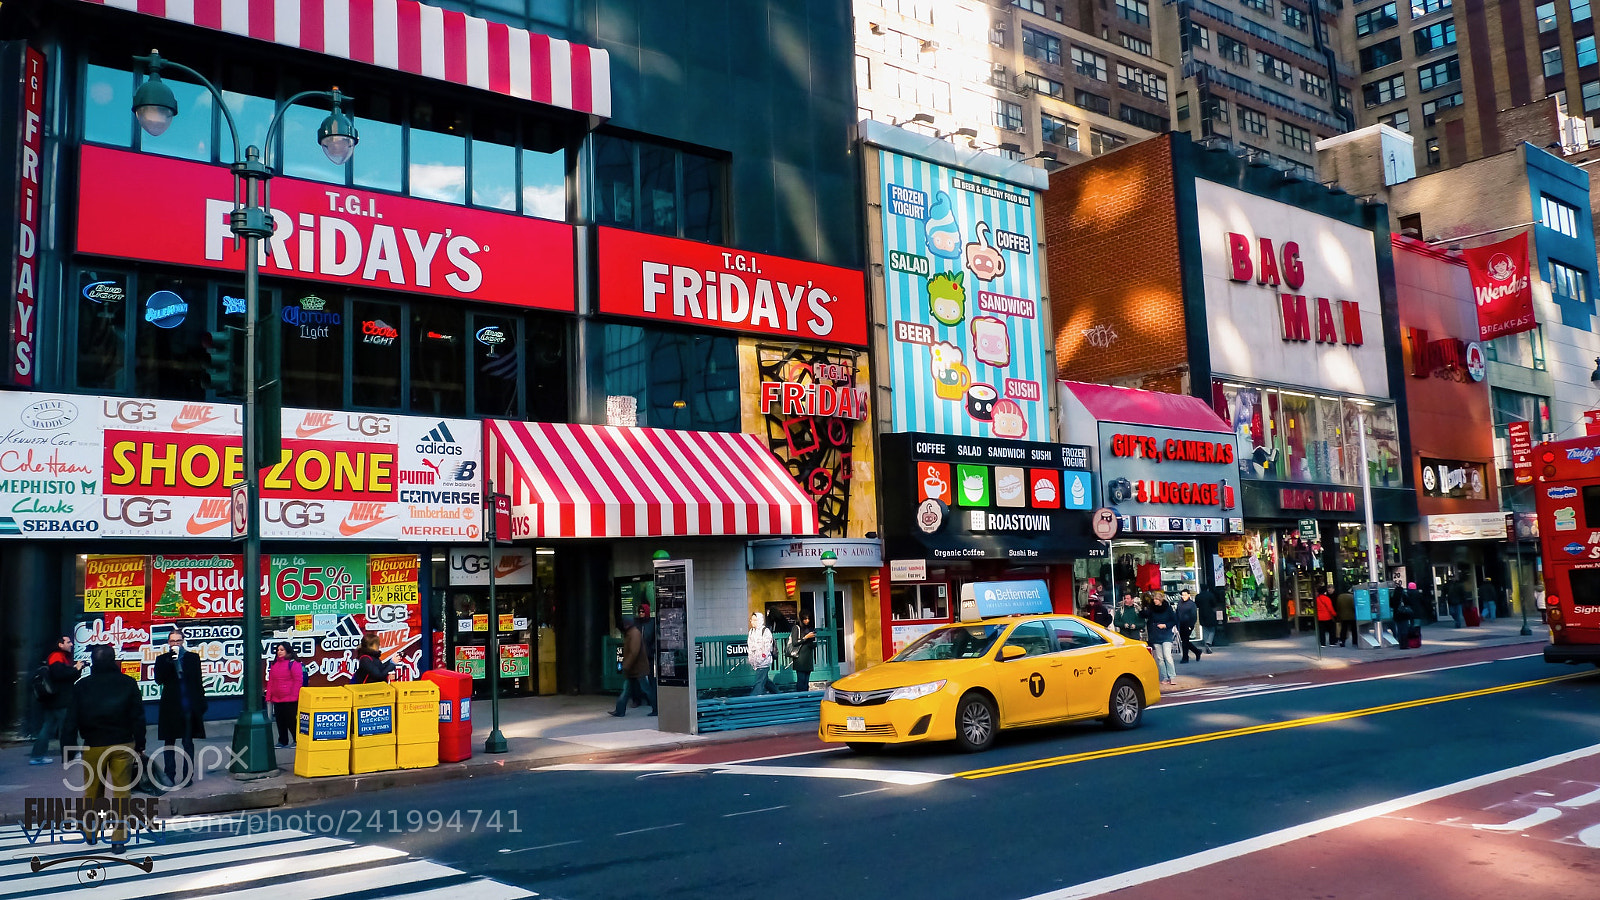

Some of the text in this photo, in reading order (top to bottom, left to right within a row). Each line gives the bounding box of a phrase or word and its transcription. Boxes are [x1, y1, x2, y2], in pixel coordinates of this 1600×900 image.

[892, 186, 924, 206] FROZEN
[976, 185, 981, 193] &
[982, 187, 1004, 199] HEALTHY
[1005, 193, 1018, 202] FOOD
[1018, 197, 1030, 206] BAR
[325, 191, 383, 218] T.G.I.
[892, 201, 925, 220] YOGURT
[997, 231, 1030, 252] COFFEE
[721, 252, 762, 274] T.G.I.
[891, 253, 929, 275] SALAD
[1224, 232, 1305, 290] BAG
[642, 260, 834, 336] FRiDAY'S
[980, 293, 1034, 317] SANDWICH
[281, 305, 341, 327] Corona
[1276, 293, 1364, 346] MAN
[300, 324, 329, 340] Light
[362, 320, 398, 338] Coors
[1480, 314, 1533, 335] BREAKFAS
[363, 334, 395, 346] LIGHT
[899, 323, 932, 344] BEER
[819, 363, 847, 381] T.G.I.
[1008, 380, 1038, 399] SUSHI
[31, 401, 64, 412] STEVE
[103, 400, 157, 424] UGG
[179, 404, 214, 421] NIKE
[31, 414, 72, 429] MADDEN
[302, 412, 335, 428] NIKE
[346, 414, 391, 437] UGG
[415, 442, 463, 457] adidas
[916, 442, 946, 455] COFFEE
[957, 445, 982, 457] SALAD
[987, 447, 1026, 460] SANDWICH
[1031, 449, 1051, 461] SUSHI
[1061, 447, 1087, 458] FROZEN
[1111, 433, 1233, 464] GIFTS, CAMERAS
[1513, 448, 1531, 456] LUNCH
[0, 447, 92, 478] Cole Haan
[110, 440, 394, 493] SHOE ZONE
[1062, 457, 1087, 469] YOGURT
[1514, 461, 1532, 469] DINNER
[400, 469, 435, 485] PUMA
[0, 480, 76, 495] MEPHISTO
[1136, 480, 1220, 506] & LUGGAGE
[12, 496, 74, 514] Clarks
[400, 489, 480, 505] CONVERSE
[1280, 488, 1356, 512] BAG MAN
[103, 497, 172, 528] UGG
[196, 499, 231, 519] NIK
[264, 500, 325, 529] UGG
[348, 503, 388, 521] NIKE
[408, 505, 461, 520] Timberland
[23, 519, 99, 532] SEBAGO
[988, 513, 1051, 532] ROASTOWN
[401, 525, 466, 537] MERRELL
[780, 549, 791, 558] IN
[796, 548, 823, 557] HERE
[852, 546, 875, 556] ALWAYS
[934, 549, 985, 559] Organic Coffee
[1008, 549, 1038, 557] Sushi Bar
[87, 559, 144, 575] Blowout
[153, 556, 235, 573] Spectacular
[272, 556, 307, 569] up to
[371, 559, 417, 572] Blowout
[450, 555, 490, 575] UGG
[498, 555, 523, 568] NIKE
[96, 573, 135, 589] Sale!
[174, 569, 270, 595] Holidy
[379, 569, 410, 584] Sale!
[86, 589, 102, 598] BUY
[114, 589, 130, 598] GET
[326, 584, 365, 601] OFF
[371, 585, 409, 593] BUY GET
[386, 591, 418, 602] PRICE
[995, 587, 1041, 601] Betterment
[105, 597, 143, 609] PRICE
[285, 601, 364, 611] Name Brand Shoes
[368, 604, 408, 624] UGG
[75, 617, 147, 646] Cole Haan
[183, 625, 241, 639] SEBAGO
[378, 628, 409, 650] NIKE
[324, 636, 361, 650] adida
[727, 645, 749, 655] Subw
[316, 714, 346, 723] EPOCH
[360, 708, 389, 719] EPOCH
[360, 715, 389, 724] WEEKEND
